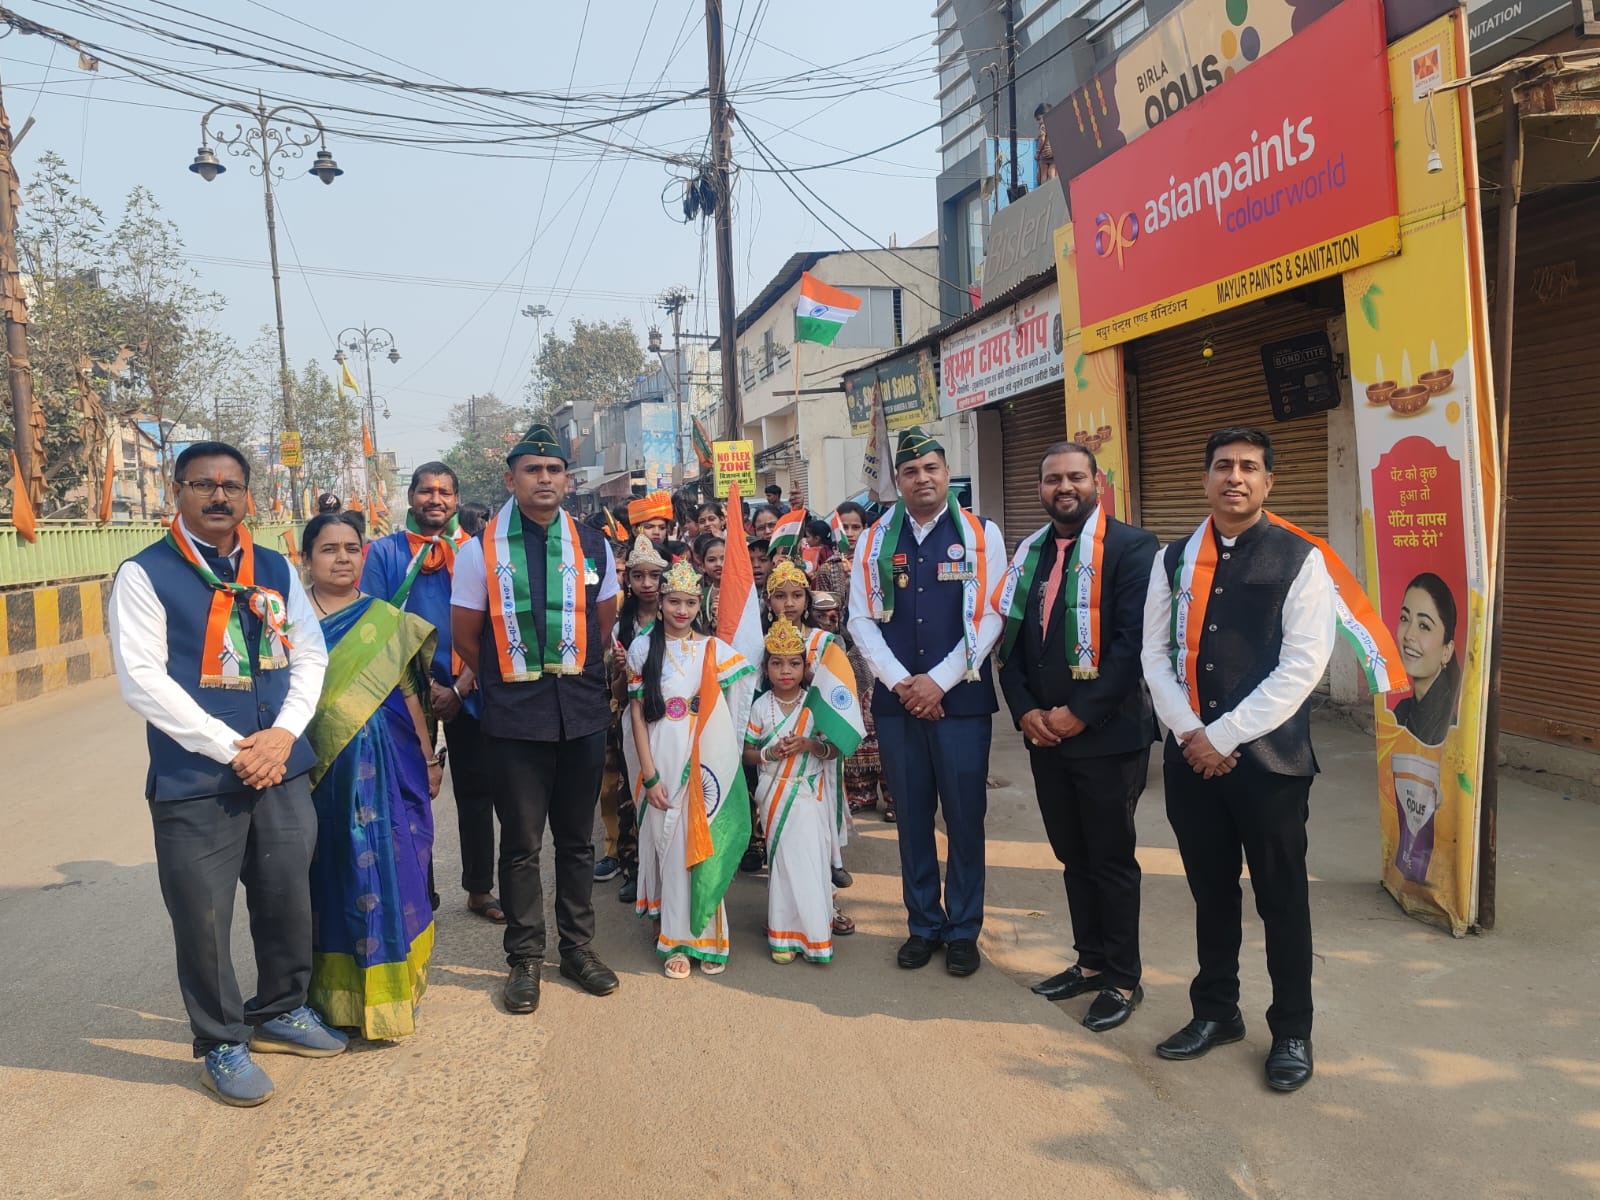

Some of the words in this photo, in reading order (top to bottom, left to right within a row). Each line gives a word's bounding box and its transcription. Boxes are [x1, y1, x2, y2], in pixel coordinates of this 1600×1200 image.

[1137, 59, 1168, 93] BIRLA
[1144, 116, 1316, 234] asianpaints
[1217, 275, 1248, 304] MAYUR
[1250, 262, 1283, 294] PAINTS
[1285, 258, 1293, 281] &
[1294, 233, 1360, 278] SANITATION
[943, 346, 975, 397] शुभम
[979, 331, 1011, 373] टायर
[1015, 305, 1049, 358] शॉप
[892, 374, 917, 399] Sales
[718, 453, 730, 462] NO
[732, 452, 750, 461] FLEX
[720, 462, 750, 472] ZONE
[1391, 466, 1403, 481] पेंट
[1405, 464, 1417, 480] को
[1419, 466, 1438, 484] कुछ
[1400, 489, 1418, 506] हुआ
[1420, 485, 1430, 501] तो
[1388, 510, 1414, 528] पेंटिंग
[1416, 512, 1447, 526] वापस
[1392, 530, 1420, 547] करके
[1406, 798, 1426, 816] opus
